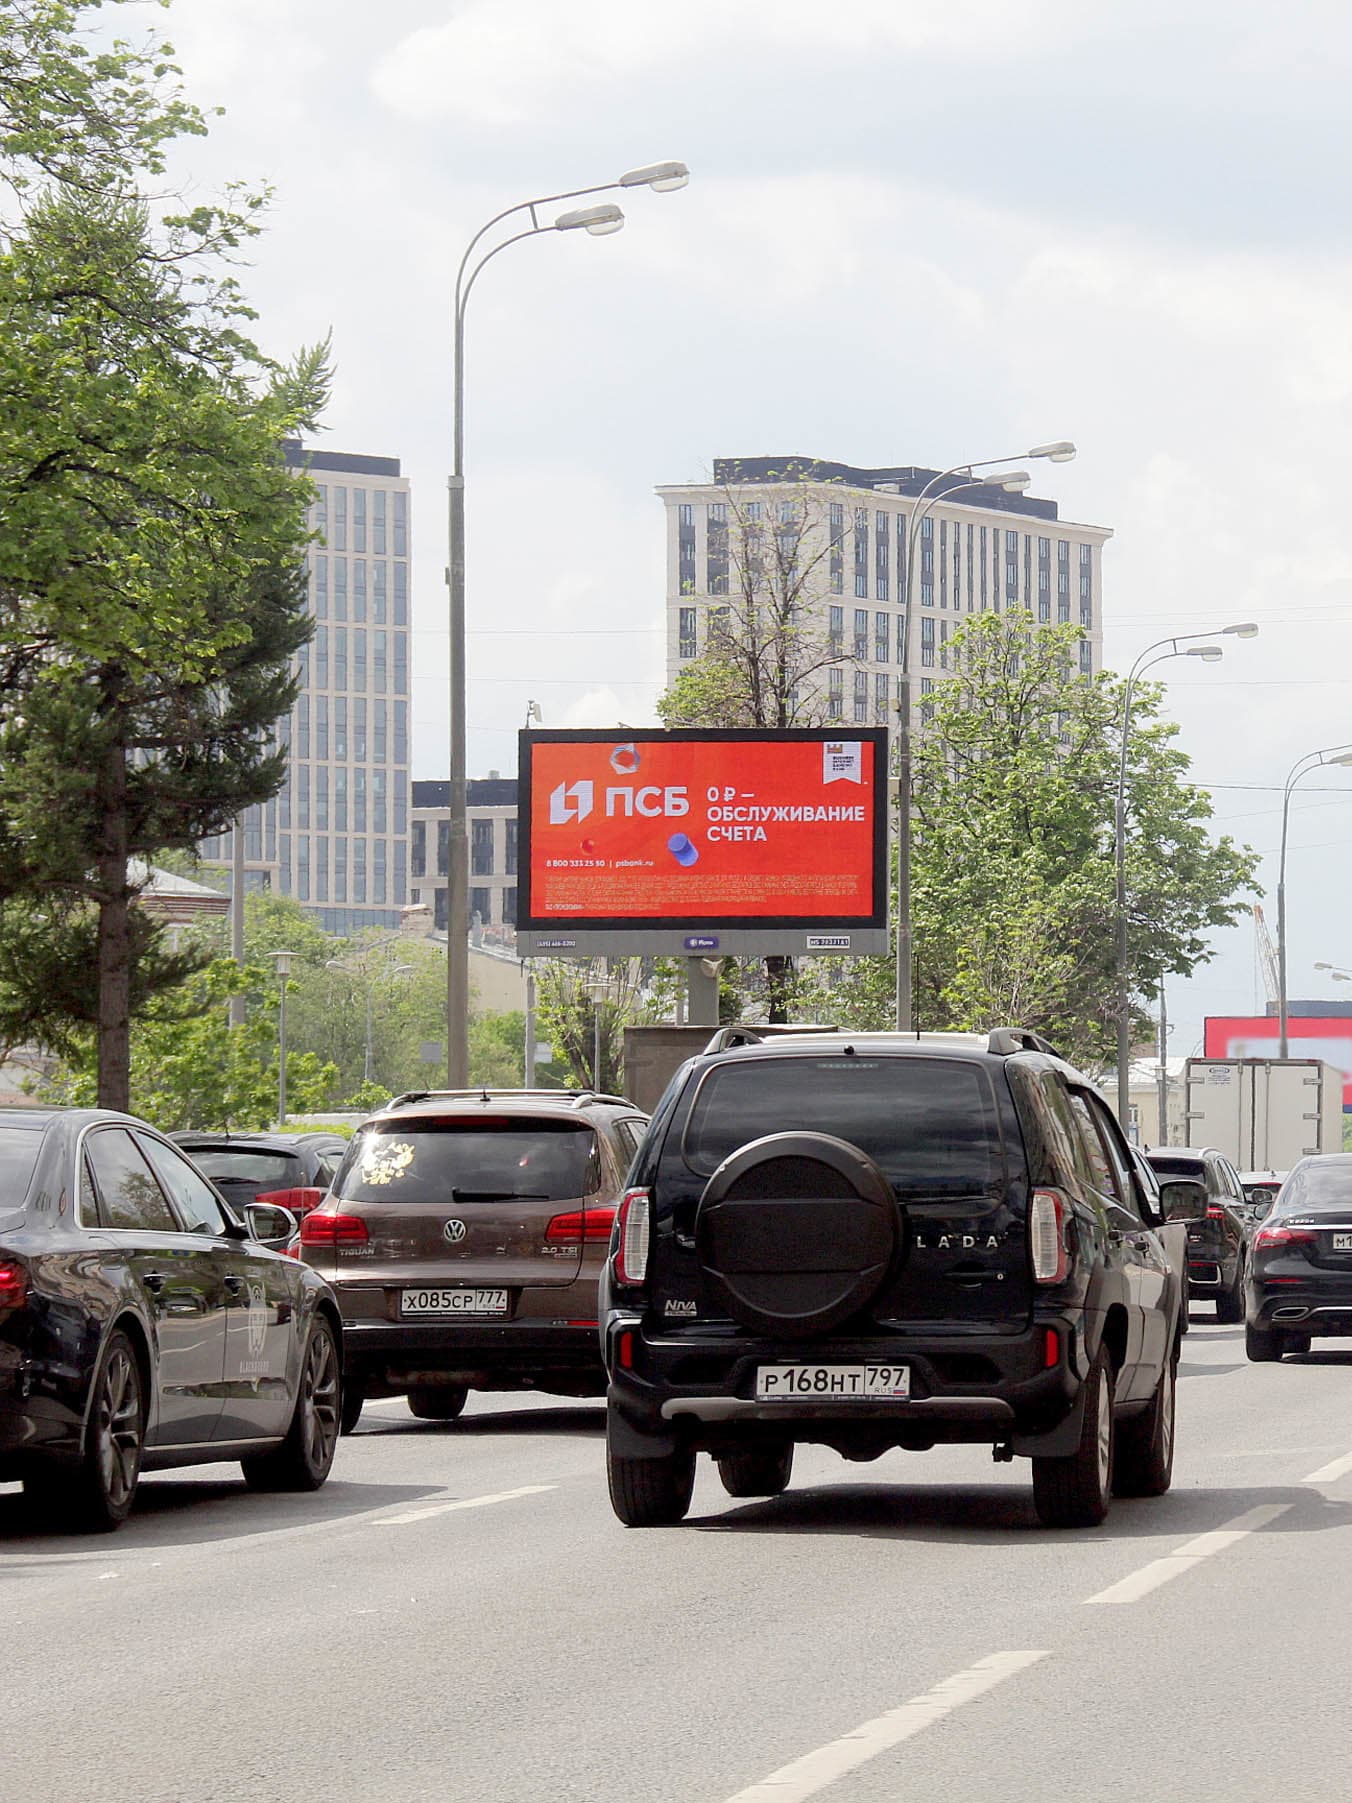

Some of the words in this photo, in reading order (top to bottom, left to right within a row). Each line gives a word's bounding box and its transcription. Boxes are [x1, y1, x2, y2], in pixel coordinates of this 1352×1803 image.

[604, 785, 690, 818] ПСБ
[706, 786, 719, 802] 0
[706, 805, 865, 822] ОБСЛУЖИВАНИЕ
[706, 826, 767, 842] СЧЕТА
[916, 1235, 999, 1249] LADA
[477, 1291, 503, 1304] 777
[867, 1367, 905, 1387] 797
